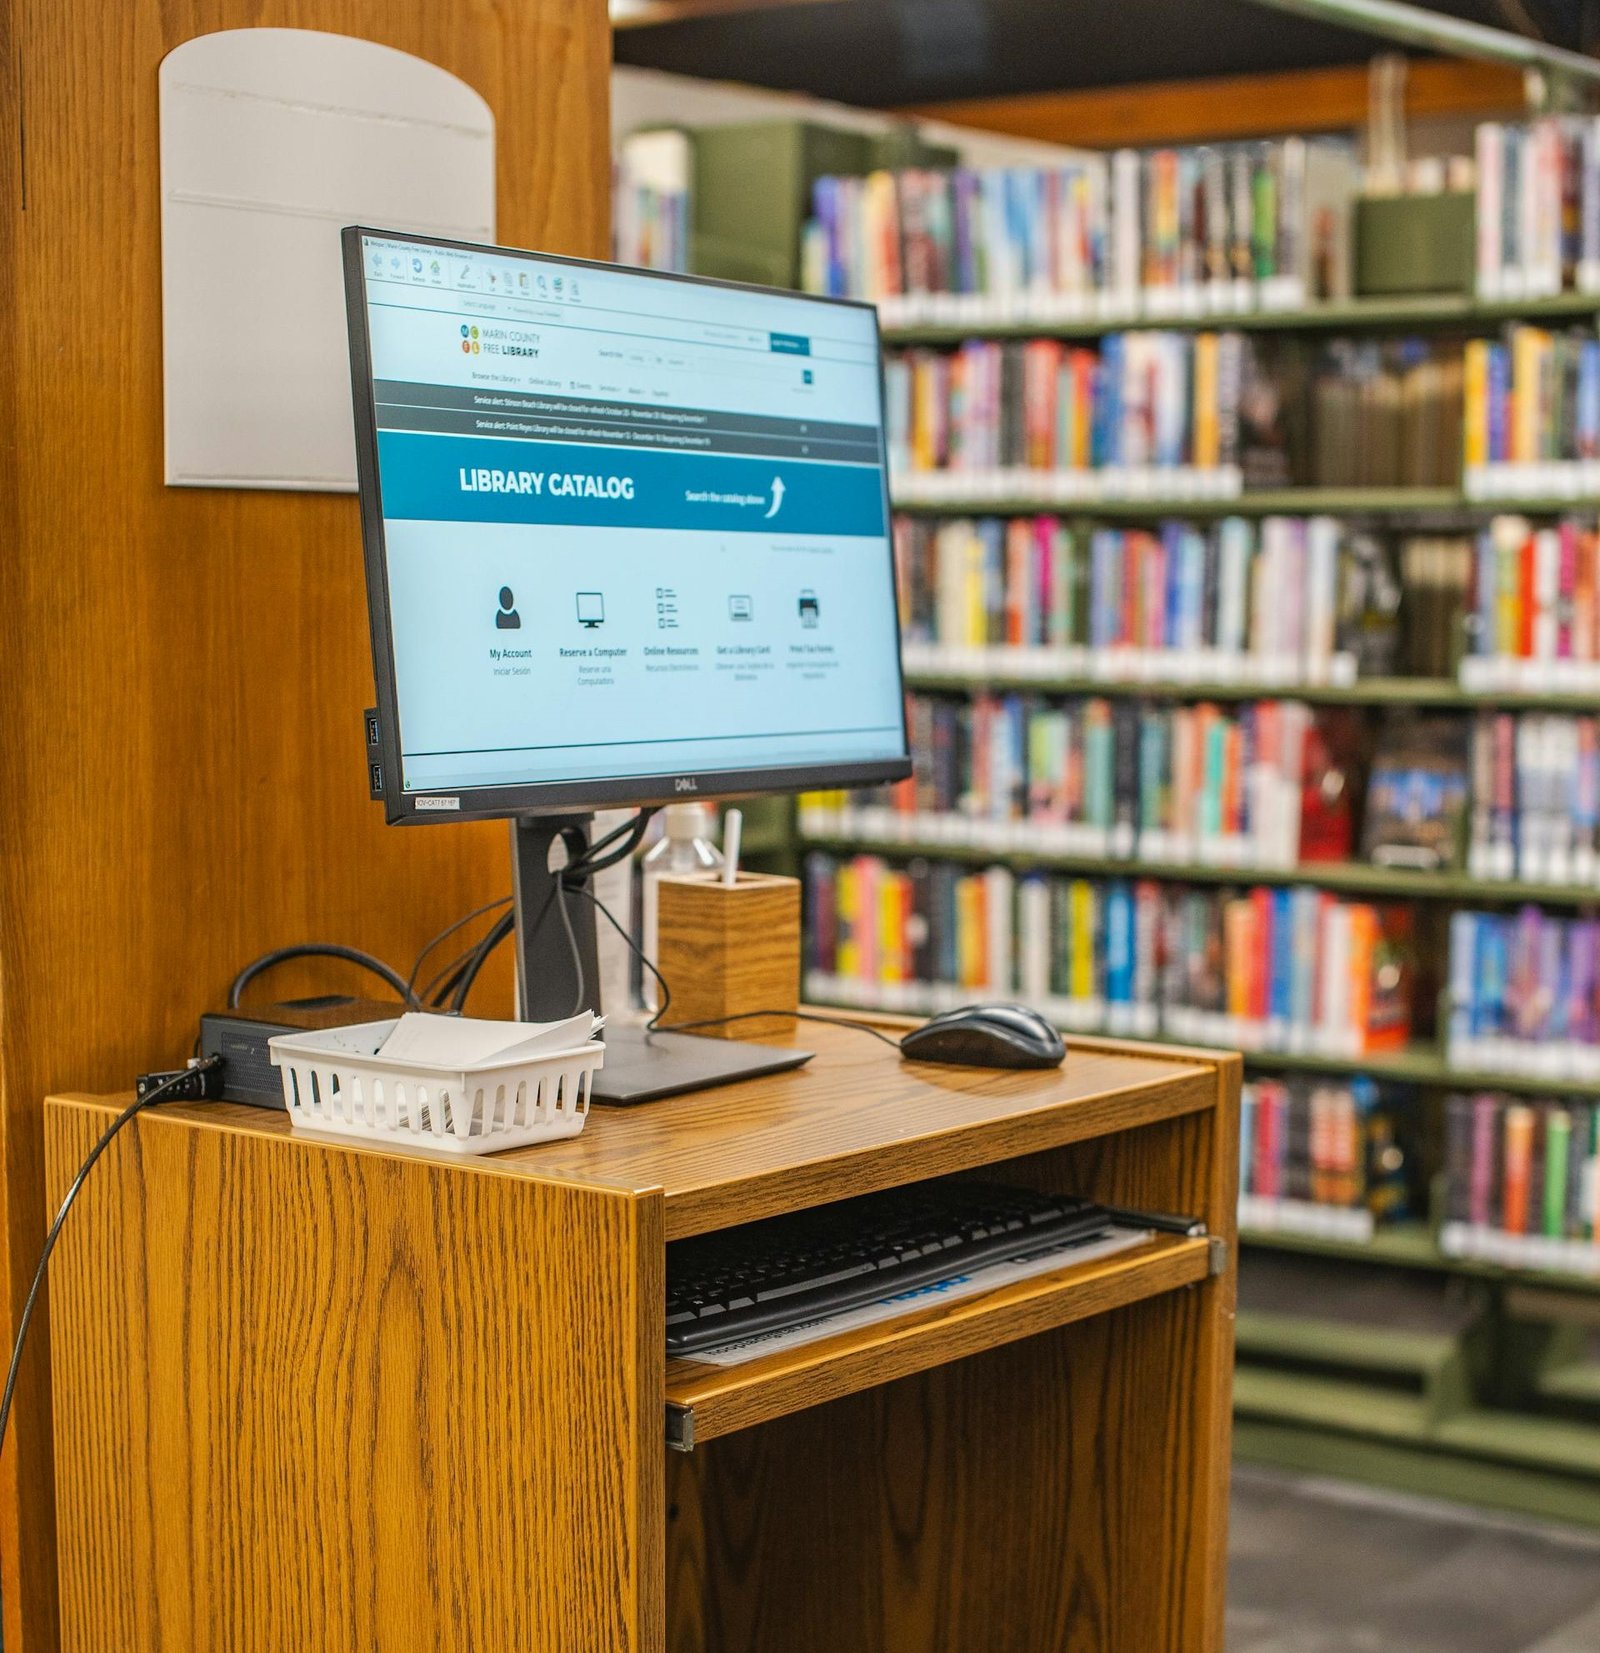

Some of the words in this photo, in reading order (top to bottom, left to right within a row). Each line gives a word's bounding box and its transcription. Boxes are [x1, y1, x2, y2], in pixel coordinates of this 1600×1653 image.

[482, 329, 507, 340] MARIN
[509, 331, 540, 343] COUNTY
[483, 343, 500, 355] FREE
[502, 345, 539, 358] LIBRARY
[473, 395, 491, 405] Service
[475, 420, 493, 429] Service
[459, 468, 544, 494] LIBRARY
[548, 473, 635, 500] CATALOG
[684, 490, 707, 501] Search
[489, 649, 501, 661] My
[502, 649, 532, 659] Account
[559, 648, 587, 657] Reserve
[594, 648, 627, 658] Computer
[644, 647, 664, 656] Online
[666, 647, 699, 656] Resources
[493, 666, 511, 676] Iniciar
